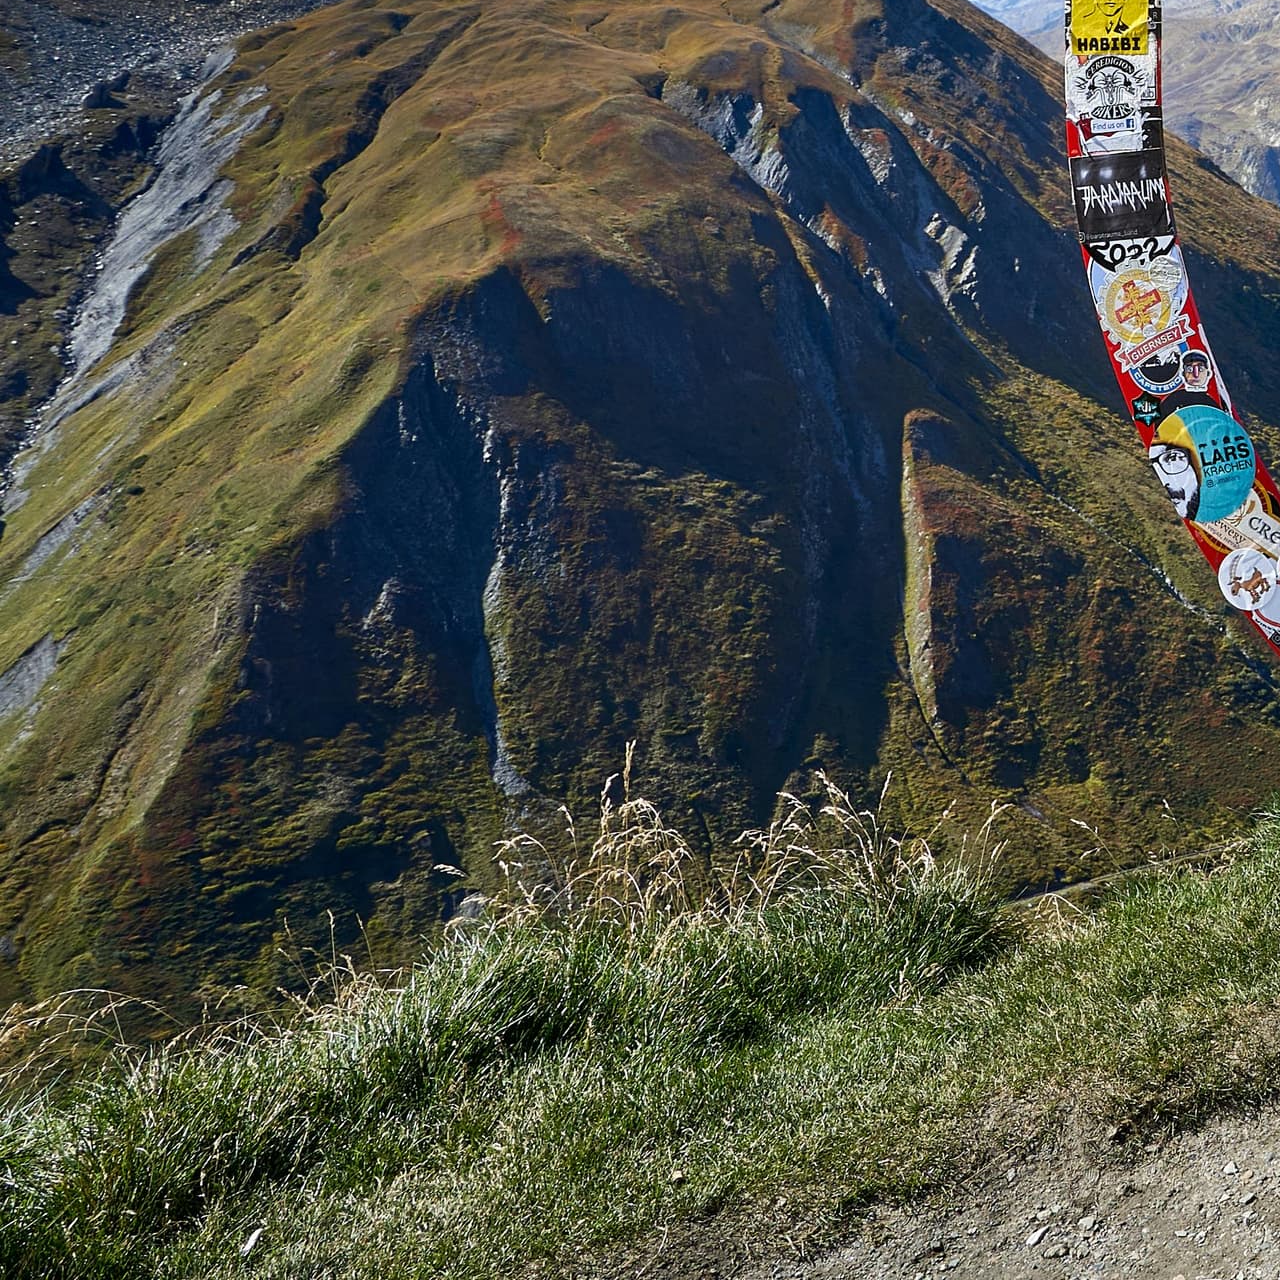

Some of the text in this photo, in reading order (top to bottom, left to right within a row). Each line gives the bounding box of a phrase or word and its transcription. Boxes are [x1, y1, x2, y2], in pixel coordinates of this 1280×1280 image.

[1077, 37, 1141, 52] HABIBI
[1086, 56, 1135, 79] CEREDIGION
[1090, 103, 1136, 120] BIKERS
[1093, 122, 1107, 131] Find
[1131, 329, 1180, 361] GUERNSEY
[1133, 372, 1184, 393] CAFETERO
[1200, 443, 1251, 467] LARS
[1203, 460, 1254, 478] KRACHEN
